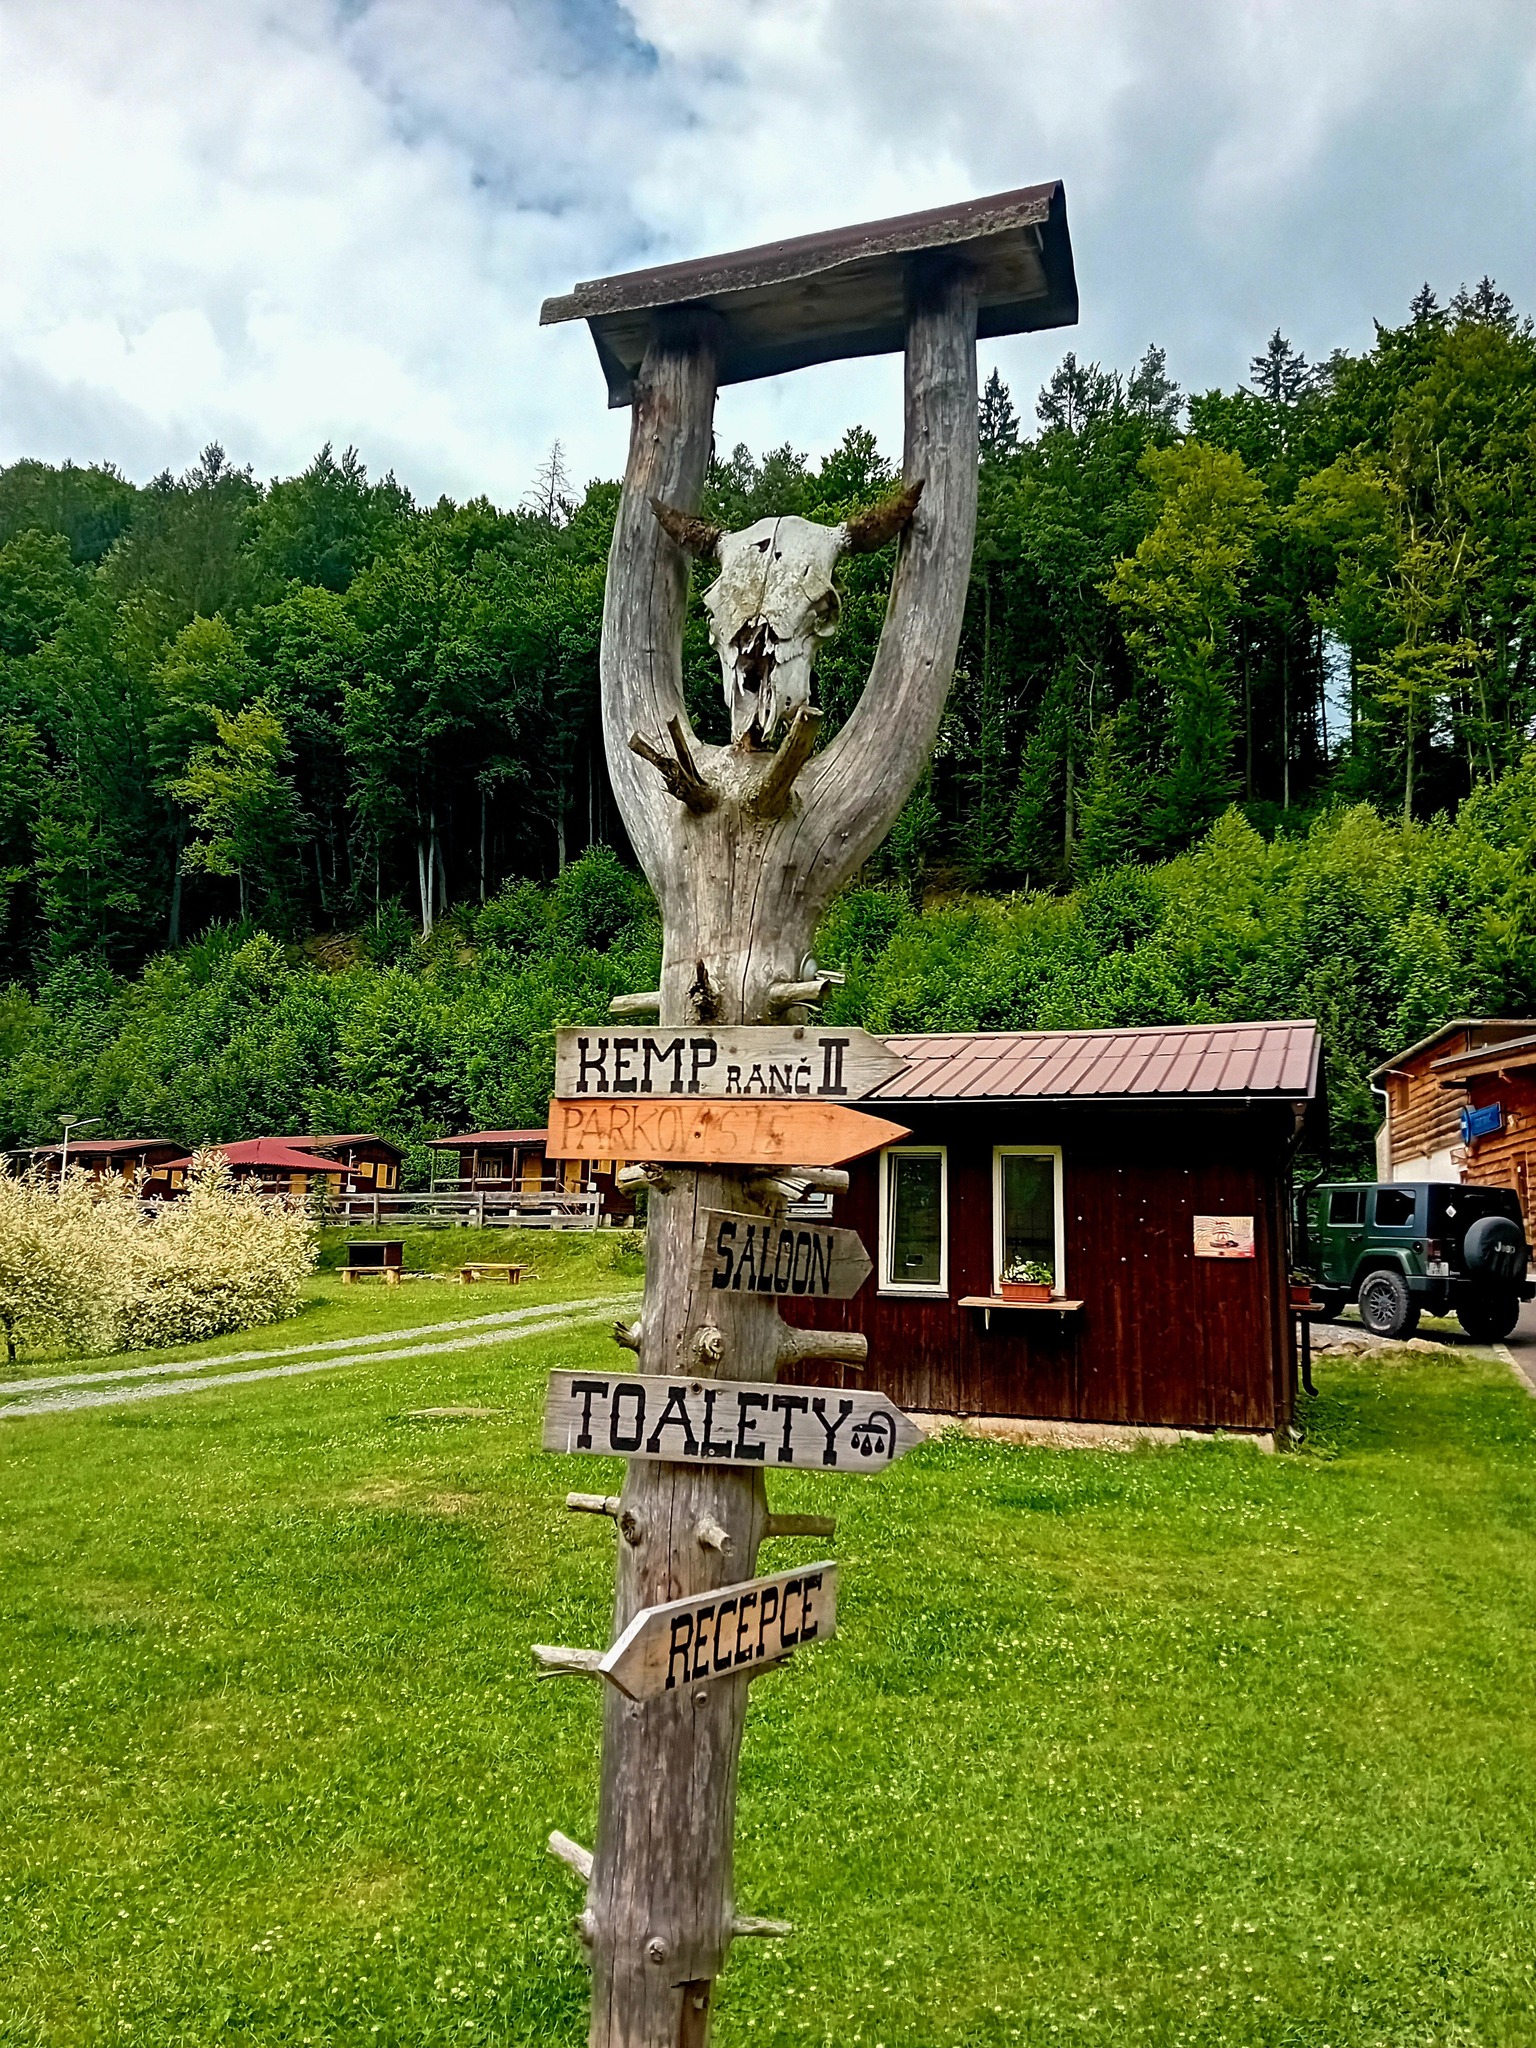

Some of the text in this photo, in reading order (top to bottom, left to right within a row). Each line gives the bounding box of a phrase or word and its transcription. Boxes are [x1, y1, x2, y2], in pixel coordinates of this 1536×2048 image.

[575, 1036, 718, 1094] KEMP
[725, 1055, 812, 1095] RANČ
[711, 1220, 834, 1295] SALOON
[571, 1380, 854, 1467] TOALETY
[665, 1572, 824, 1691] RECEPCE
